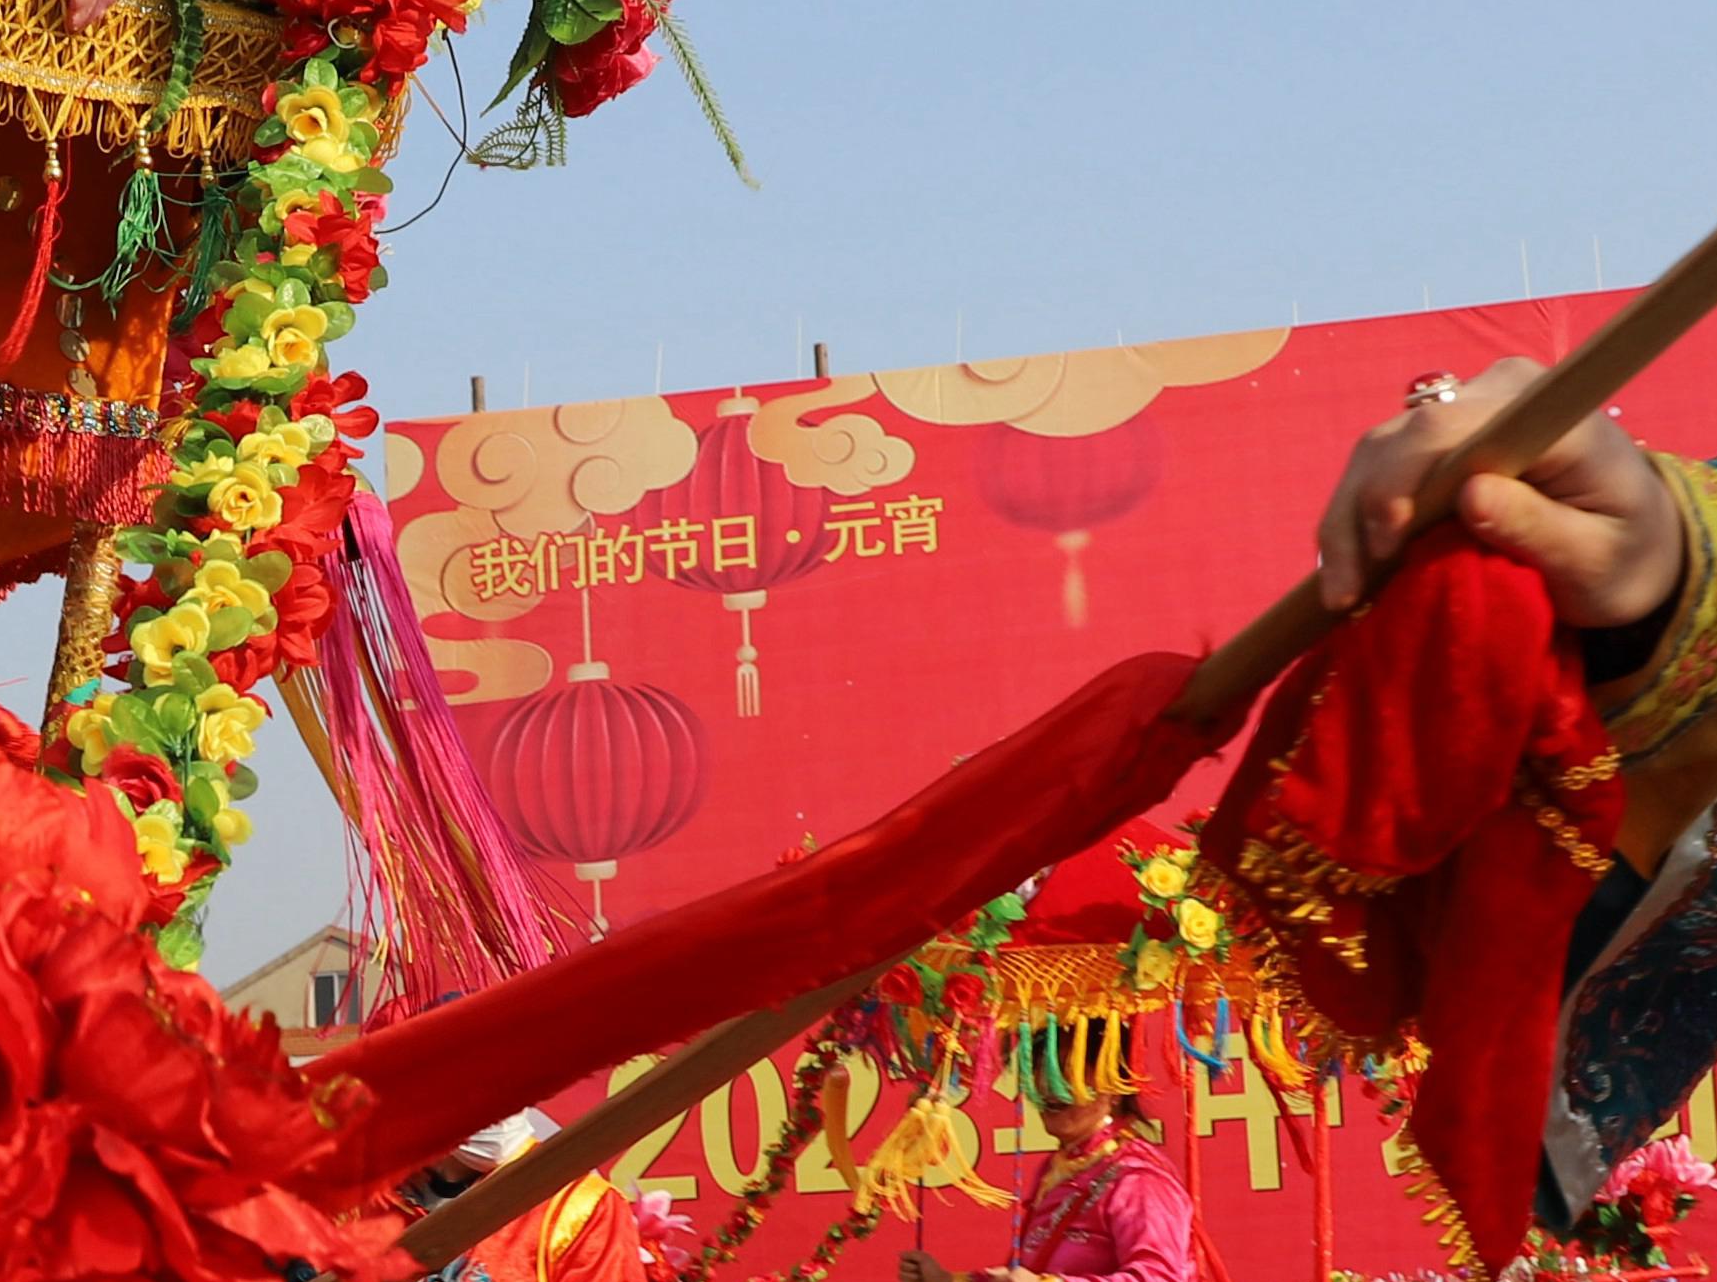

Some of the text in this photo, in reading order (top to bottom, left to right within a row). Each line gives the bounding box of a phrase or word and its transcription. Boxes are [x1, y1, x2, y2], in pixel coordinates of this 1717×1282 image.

[470, 493, 945, 603] 我们的节日·元宵
